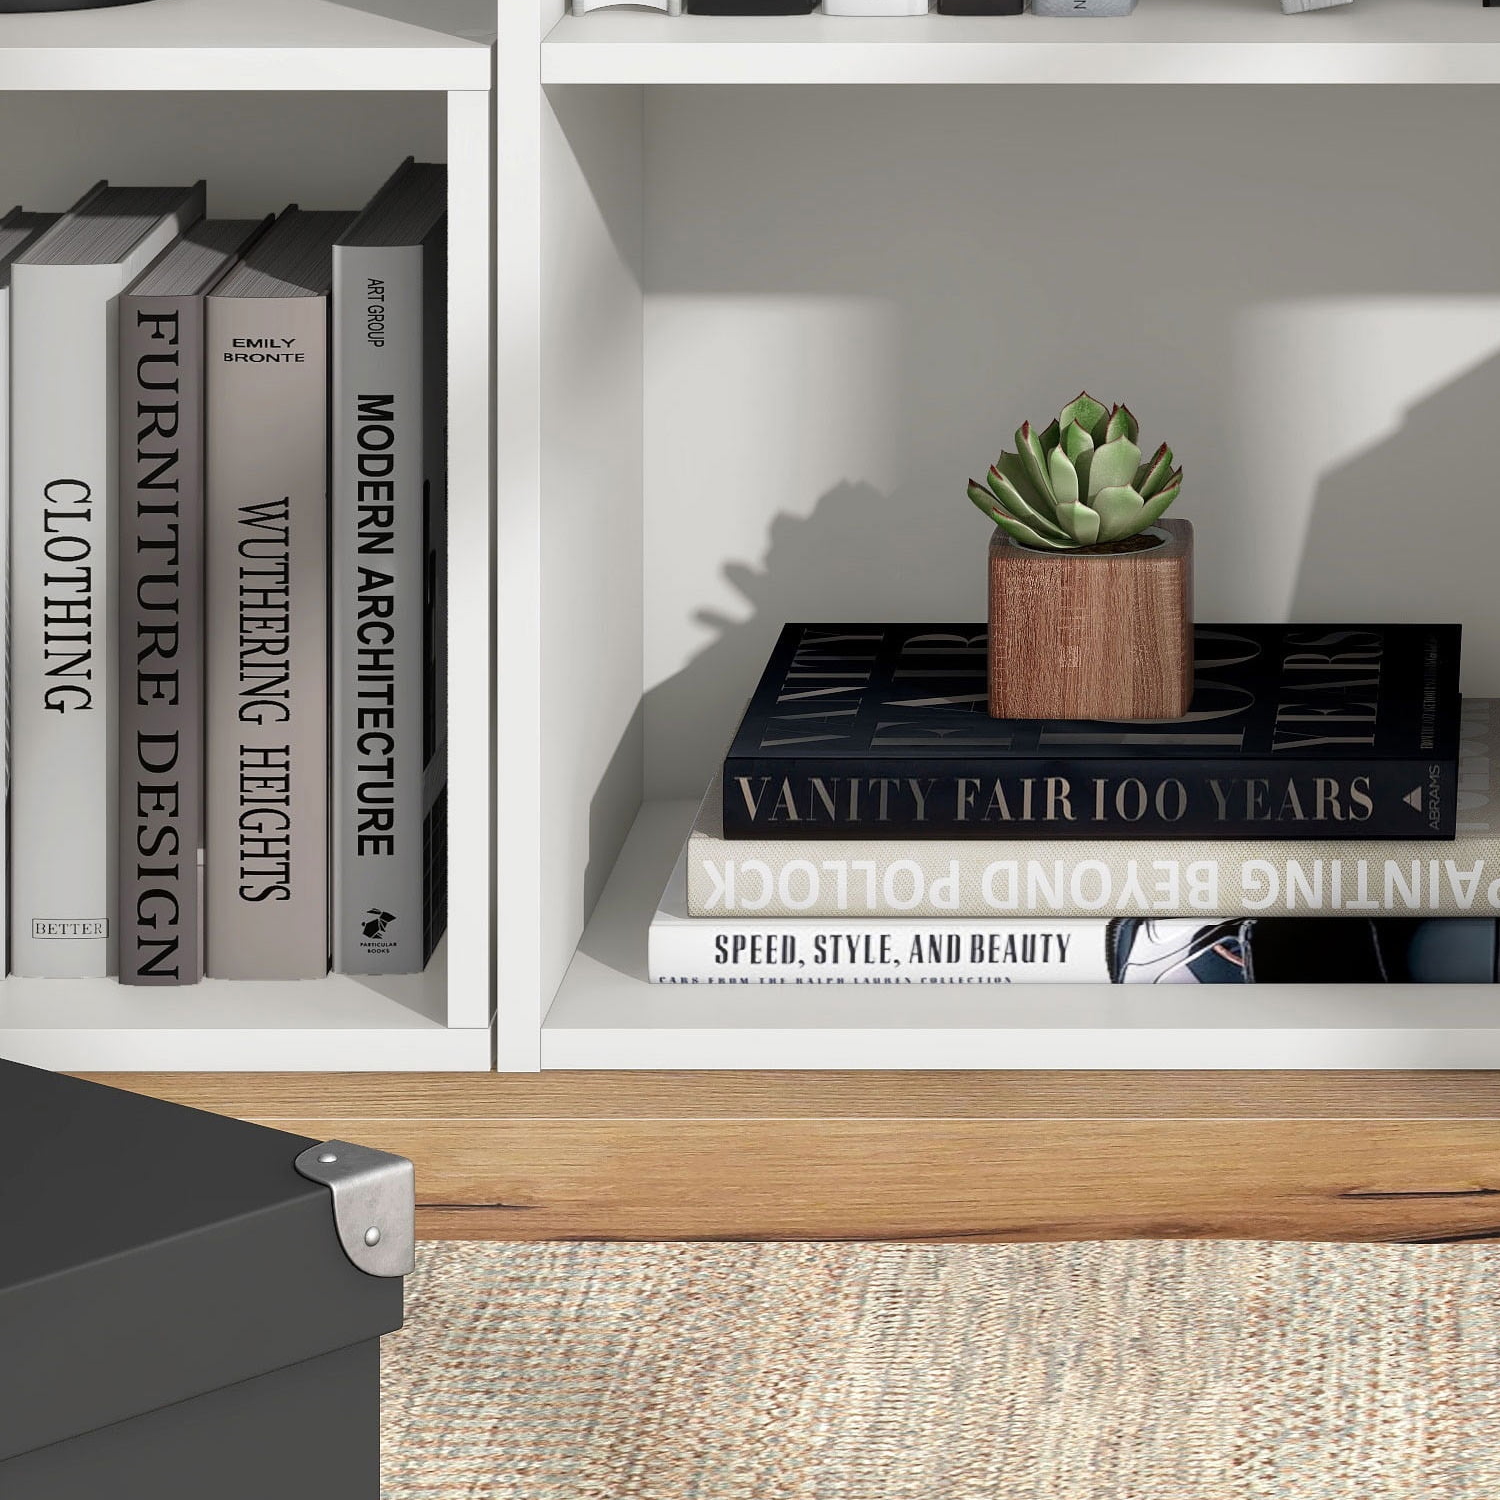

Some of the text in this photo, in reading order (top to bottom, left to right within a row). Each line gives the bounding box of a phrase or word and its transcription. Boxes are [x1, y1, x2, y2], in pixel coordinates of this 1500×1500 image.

[367, 277, 385, 348] ART GROUP
[223, 352, 305, 363] BRONTE
[232, 338, 296, 349] EMILY
[43, 478, 93, 714] CLOTHING
[356, 394, 395, 857] MODERN ARCHITECTURE
[136, 309, 180, 980] FURNITURE DESIGN
[237, 496, 291, 902] WUTHERING HEIGHTS
[1271, 630, 1385, 752] YEARS
[733, 776, 1375, 821] VANITY FAIR 100 YEARS
[1428, 763, 1440, 831] ABRAMS
[702, 859, 960, 910] POLLOCK
[982, 859, 1219, 910] BEYOND
[35, 922, 104, 936] BETTER
[715, 933, 1072, 969] SPEED, STYLE, AND BEAUTY
